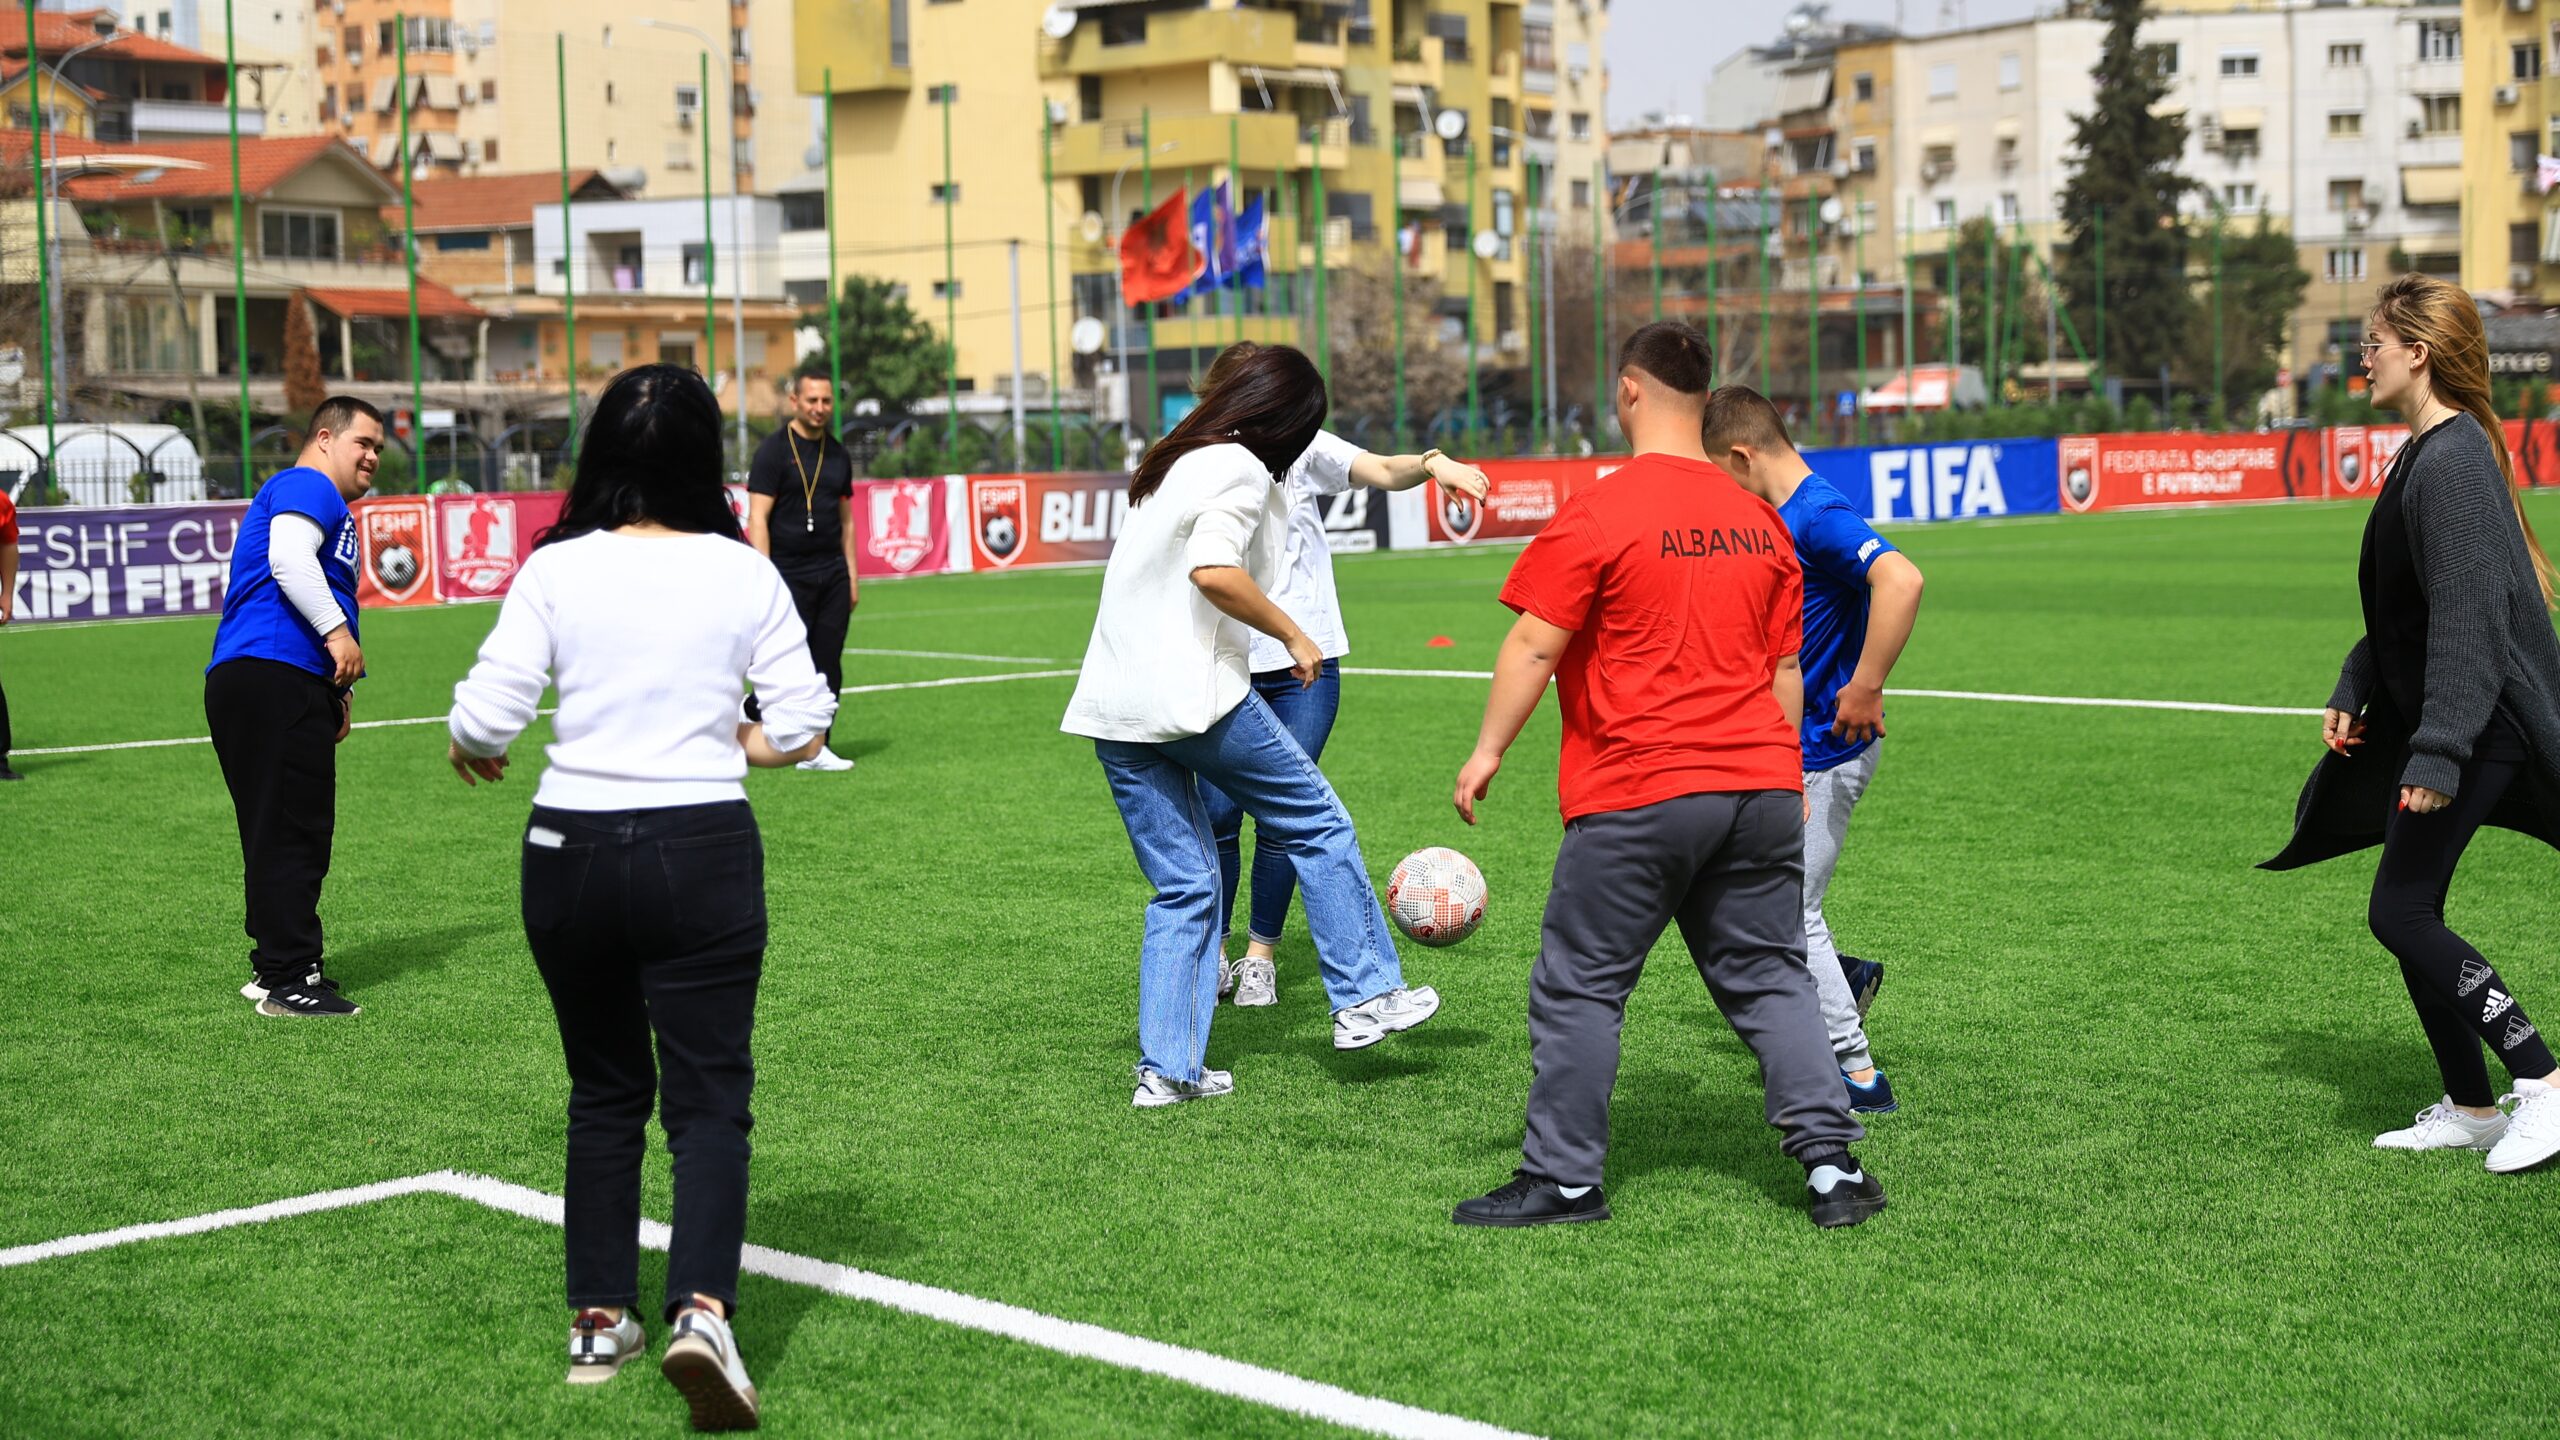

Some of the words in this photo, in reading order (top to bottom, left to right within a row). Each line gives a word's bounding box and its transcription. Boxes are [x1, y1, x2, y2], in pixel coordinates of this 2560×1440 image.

[2102, 449, 2189, 473] FEDERATA
[1870, 445, 2008, 521] FIFA
[2142, 473, 2155, 495] E
[1661, 528, 1777, 559] ALBANIA
[1857, 537, 1881, 563] NIKE
[2457, 966, 2494, 997] adidas
